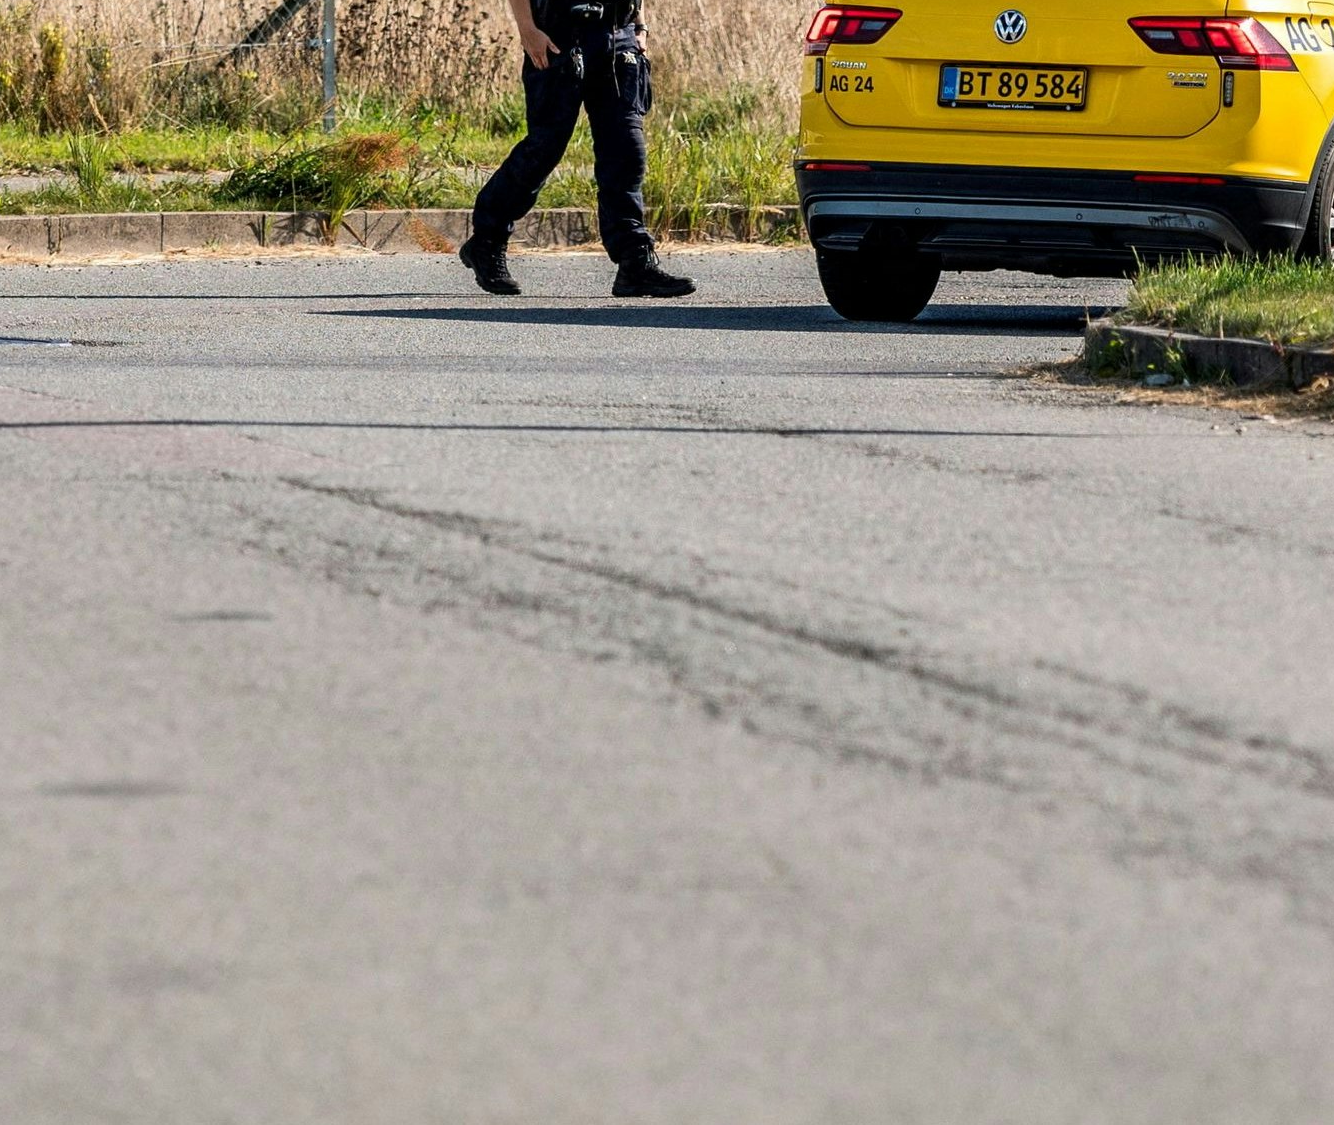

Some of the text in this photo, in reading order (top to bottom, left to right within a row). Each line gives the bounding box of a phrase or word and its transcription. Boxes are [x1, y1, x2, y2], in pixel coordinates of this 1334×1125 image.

[1284, 16, 1321, 53] AG
[829, 75, 875, 93] AG 24
[944, 71, 1083, 100] DK BT 89 584
